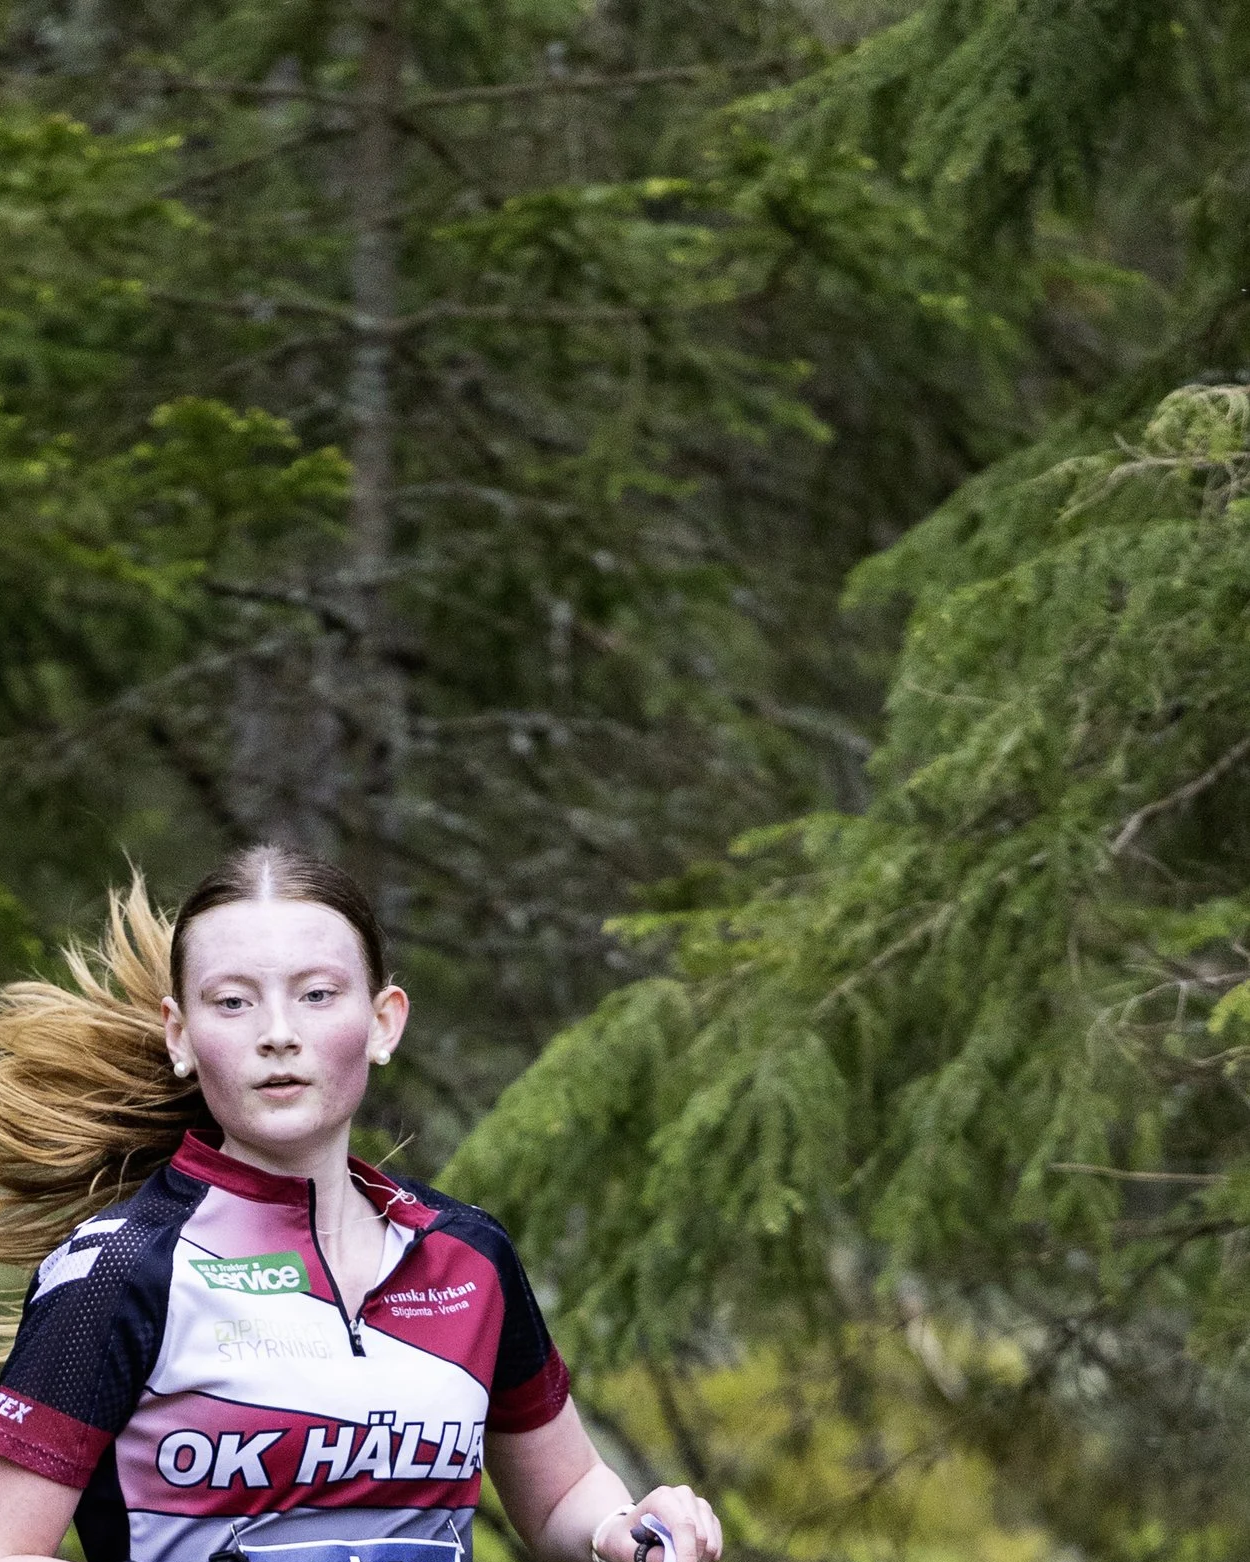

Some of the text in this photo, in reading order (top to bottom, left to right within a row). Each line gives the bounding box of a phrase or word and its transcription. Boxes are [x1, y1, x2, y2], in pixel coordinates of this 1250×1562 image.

[204, 1262, 300, 1291] service
[382, 1281, 477, 1305] venska Kyrkan
[438, 1300, 470, 1315] Vrena
[218, 1339, 328, 1363] STYRNING
[156, 1428, 290, 1490] OK
